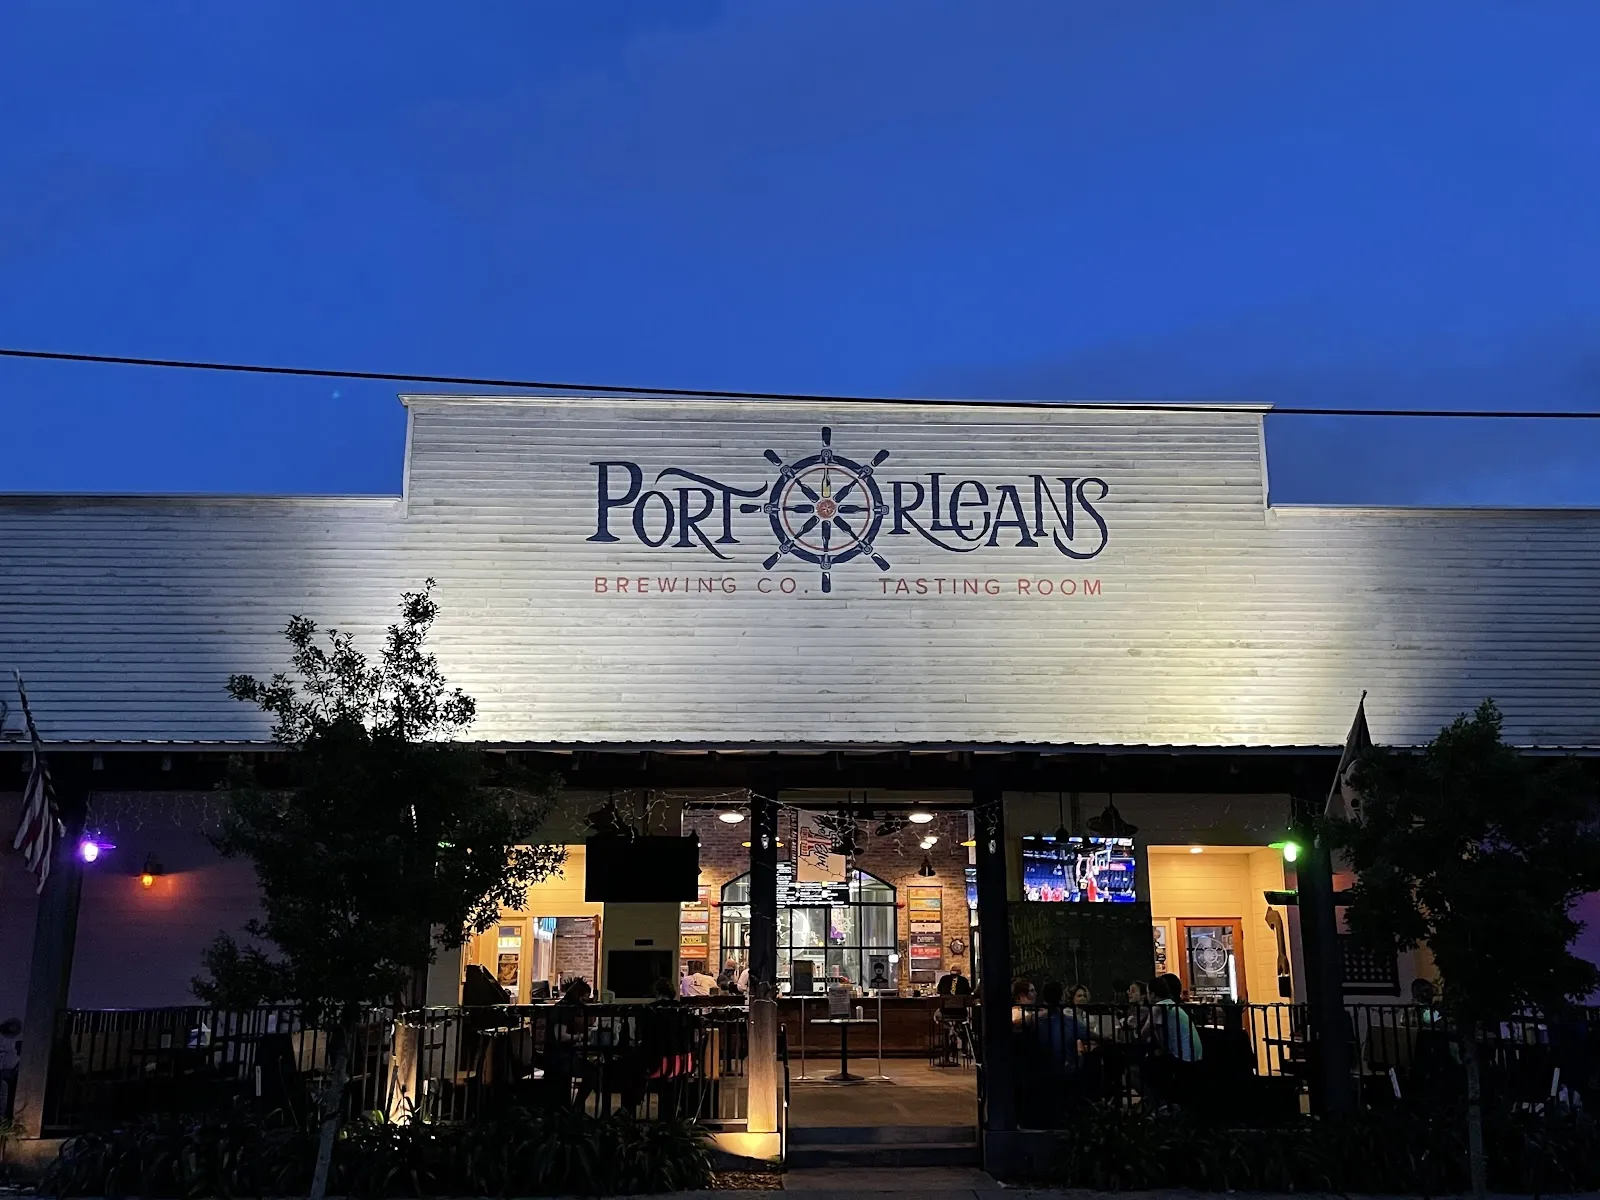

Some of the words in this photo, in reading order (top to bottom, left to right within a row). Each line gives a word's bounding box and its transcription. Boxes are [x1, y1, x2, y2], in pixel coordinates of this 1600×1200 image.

[594, 576, 737, 594] BREWING
[757, 577, 809, 594] CO.
[878, 577, 1011, 596] TASTING
[1017, 577, 1102, 596] ROOM
